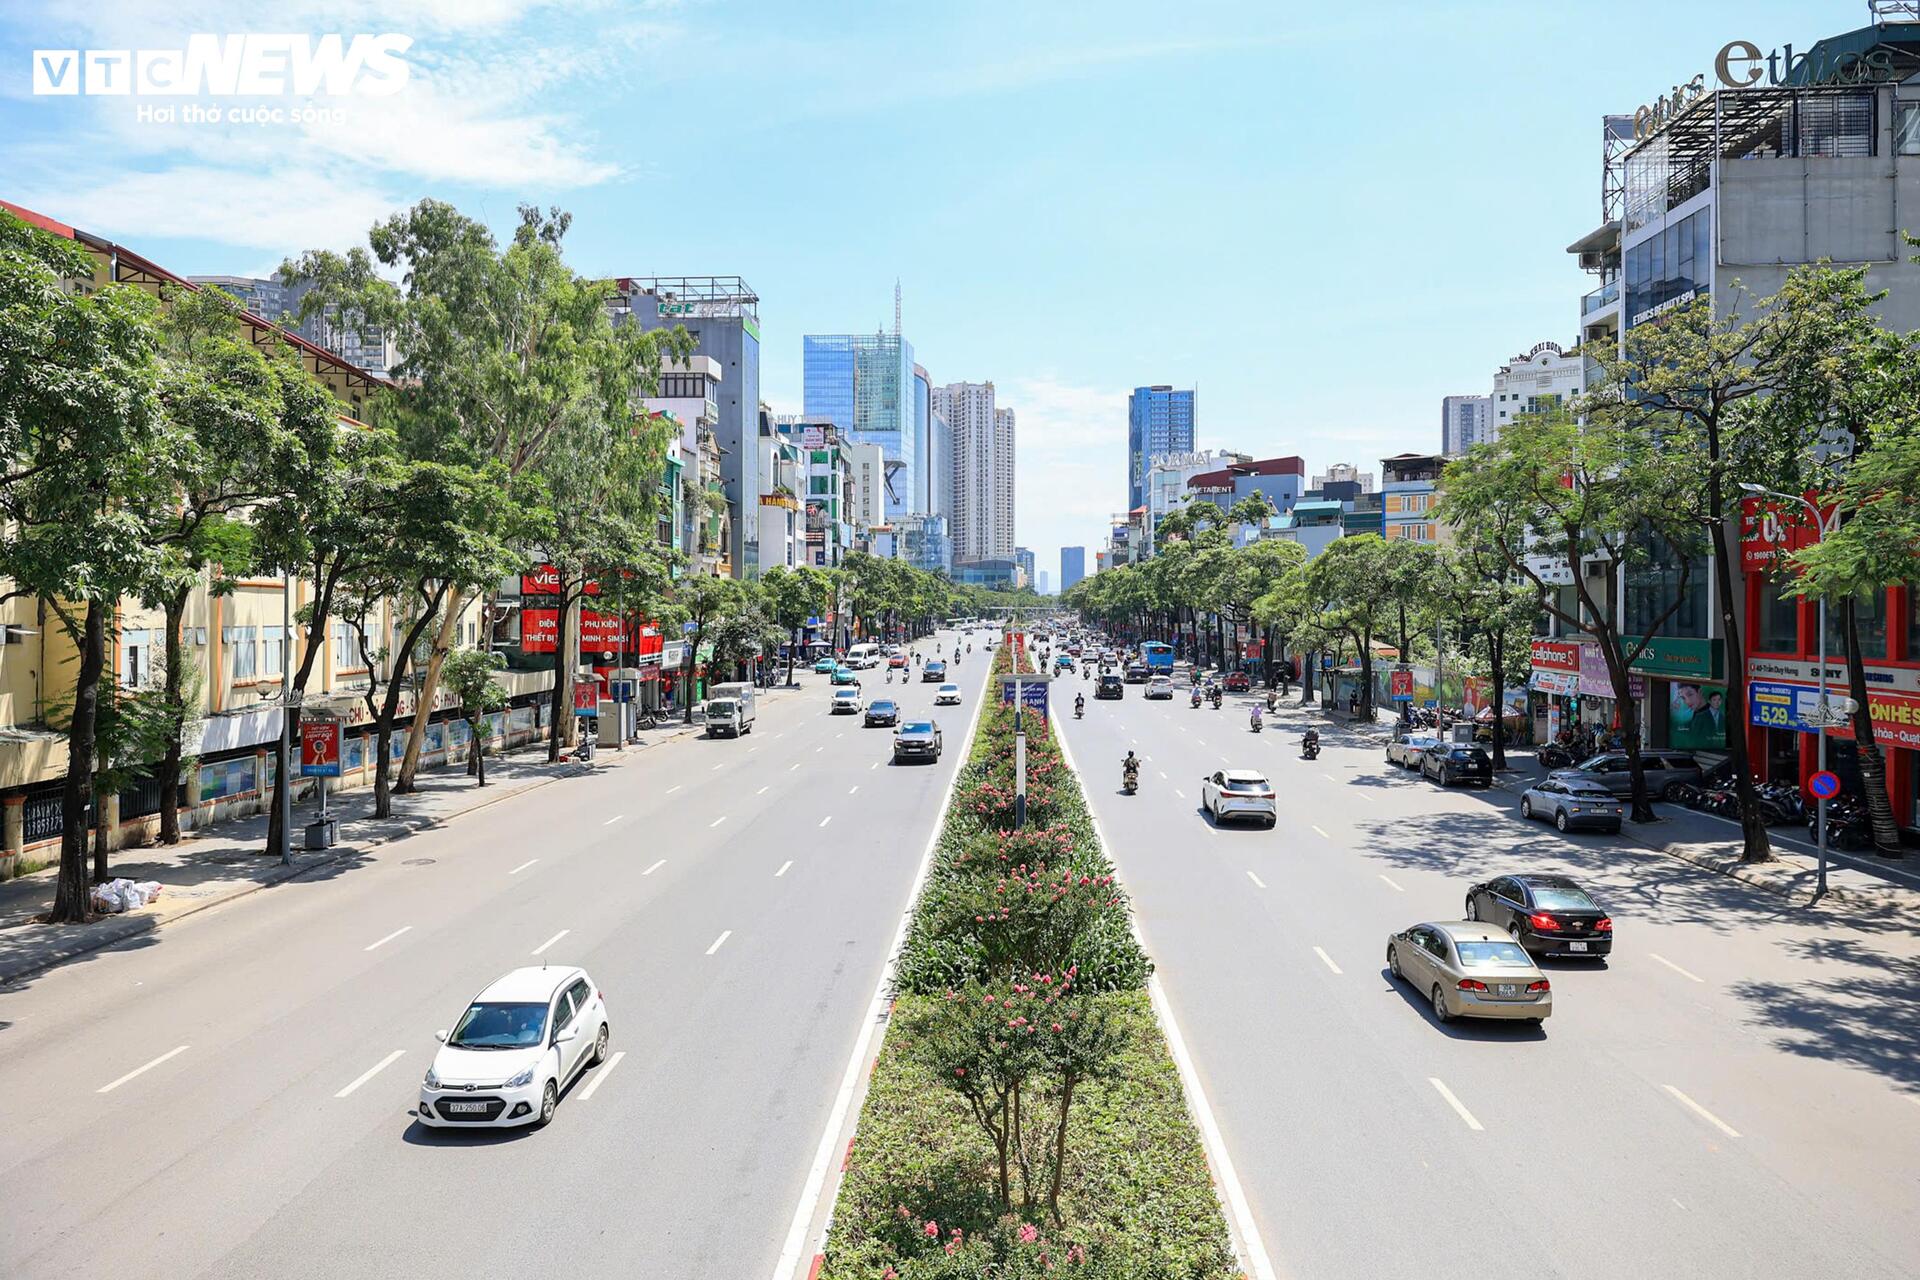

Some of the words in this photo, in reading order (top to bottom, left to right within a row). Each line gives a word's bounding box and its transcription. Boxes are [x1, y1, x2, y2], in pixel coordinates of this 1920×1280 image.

[1632, 307, 1655, 326] ETHICS
[1680, 289, 1696, 304] SPA
[538, 618, 556, 628] ĐIỆN
[584, 620, 600, 630] PHỤ
[601, 618, 618, 628] KIỆN
[525, 632, 546, 642] THIẾT
[581, 634, 601, 643] MINH
[1760, 705, 1789, 726] 5,29
[1869, 698, 1891, 721] ÓN
